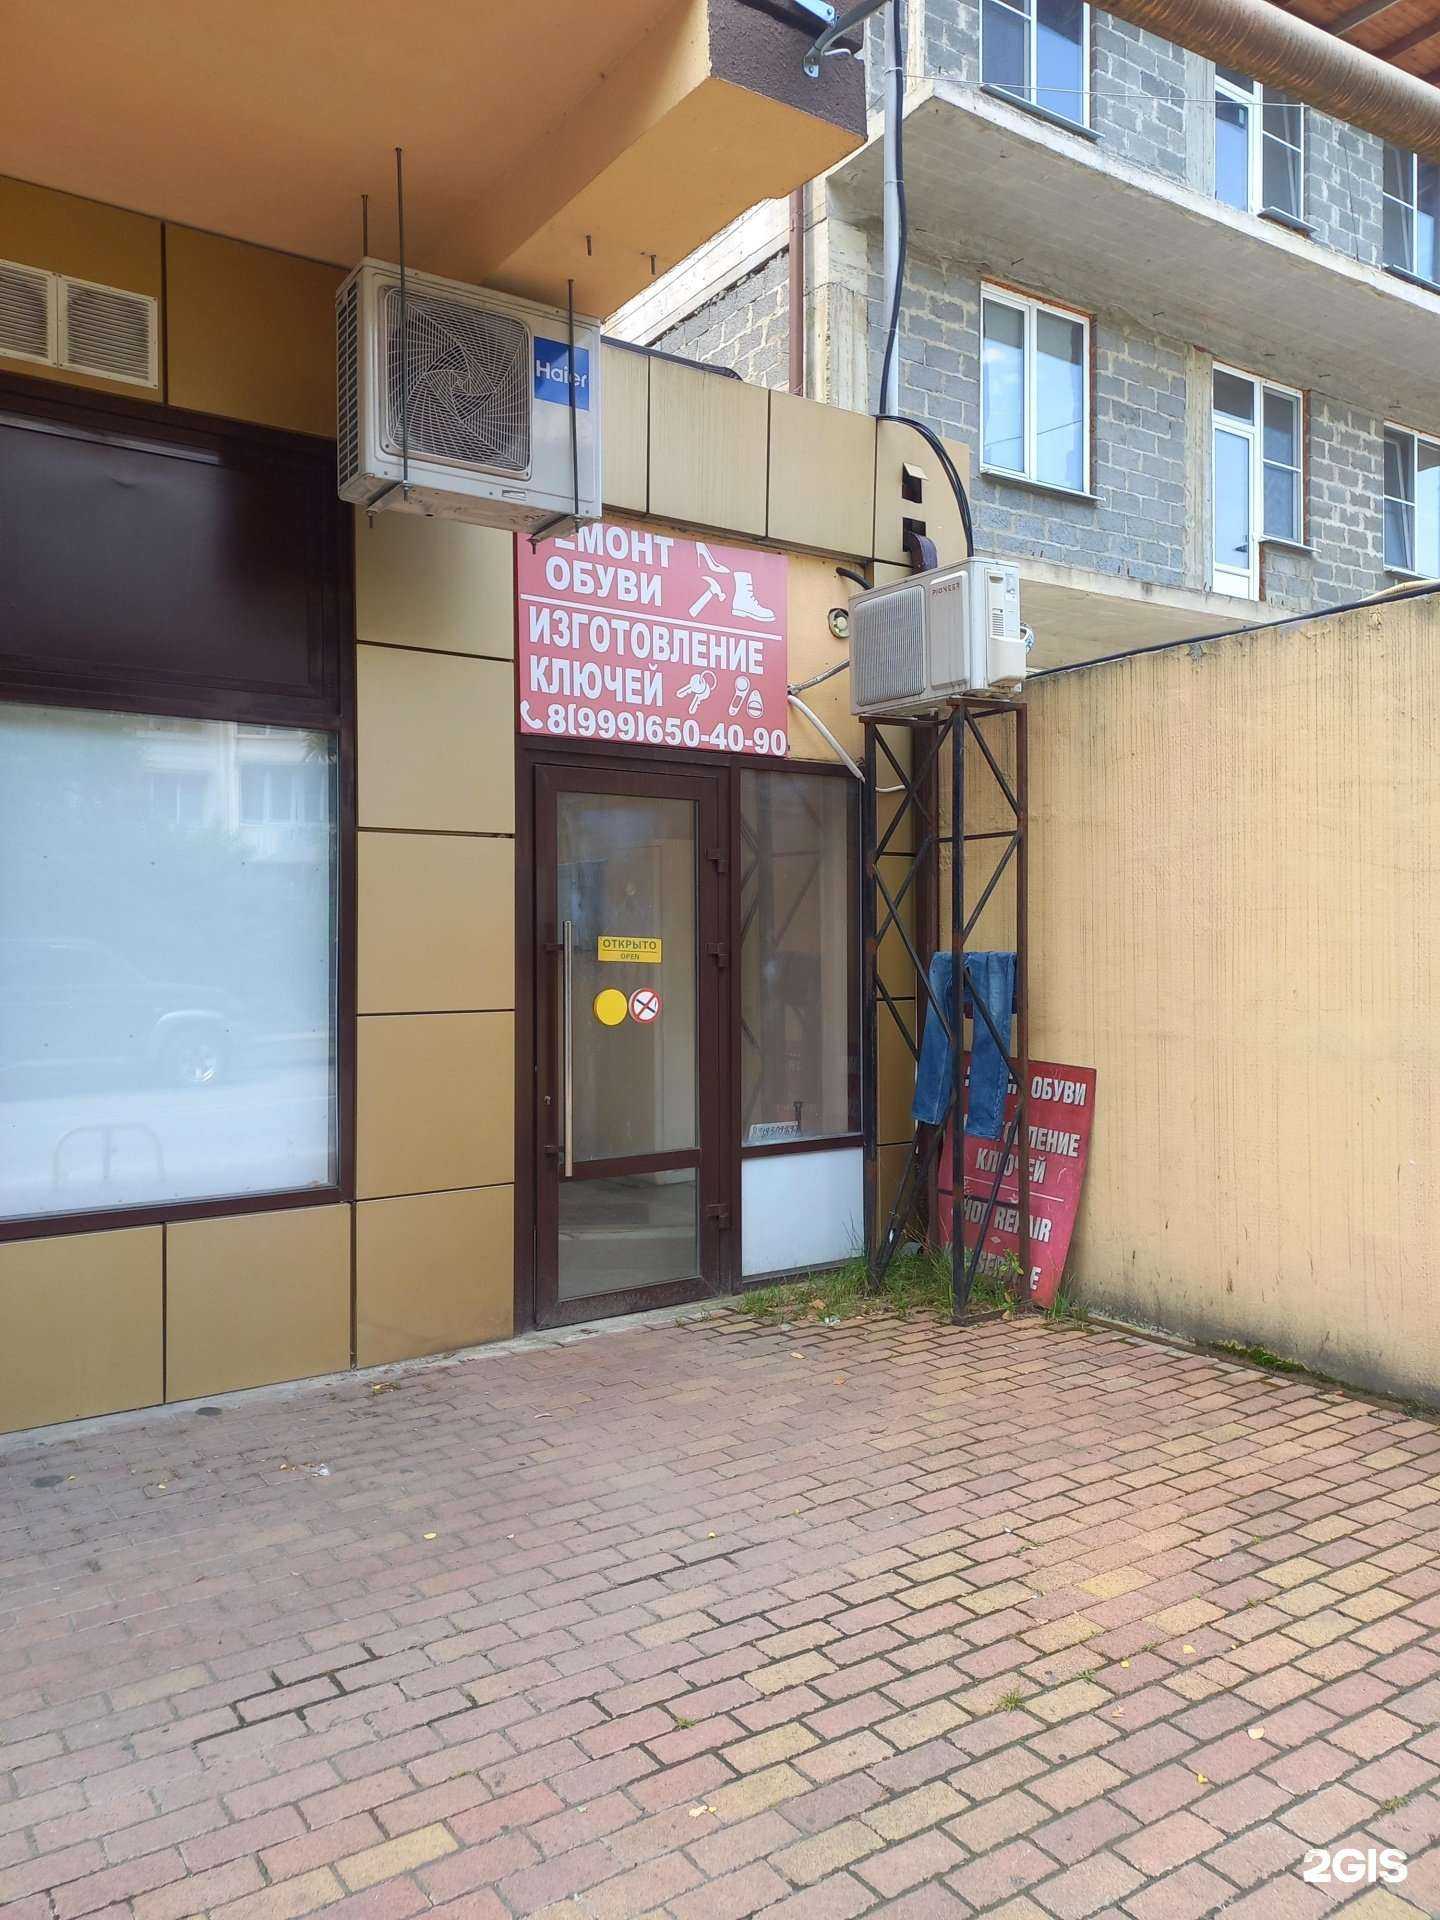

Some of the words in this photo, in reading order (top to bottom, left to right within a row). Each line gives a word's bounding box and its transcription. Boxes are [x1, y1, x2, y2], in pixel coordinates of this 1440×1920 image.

[555, 522, 674, 568] МОНТ
[545, 555, 662, 607] ОБУВИ
[529, 605, 764, 675] ИЗГОТОВЛЕНИЕ
[529, 655, 663, 707] КЛЮЧЕЙ
[547, 703, 786, 756] 8(999)650-40-90
[602, 938, 657, 950] ОТКРЫТО
[1031, 1075, 1087, 1106] ОБУВИ
